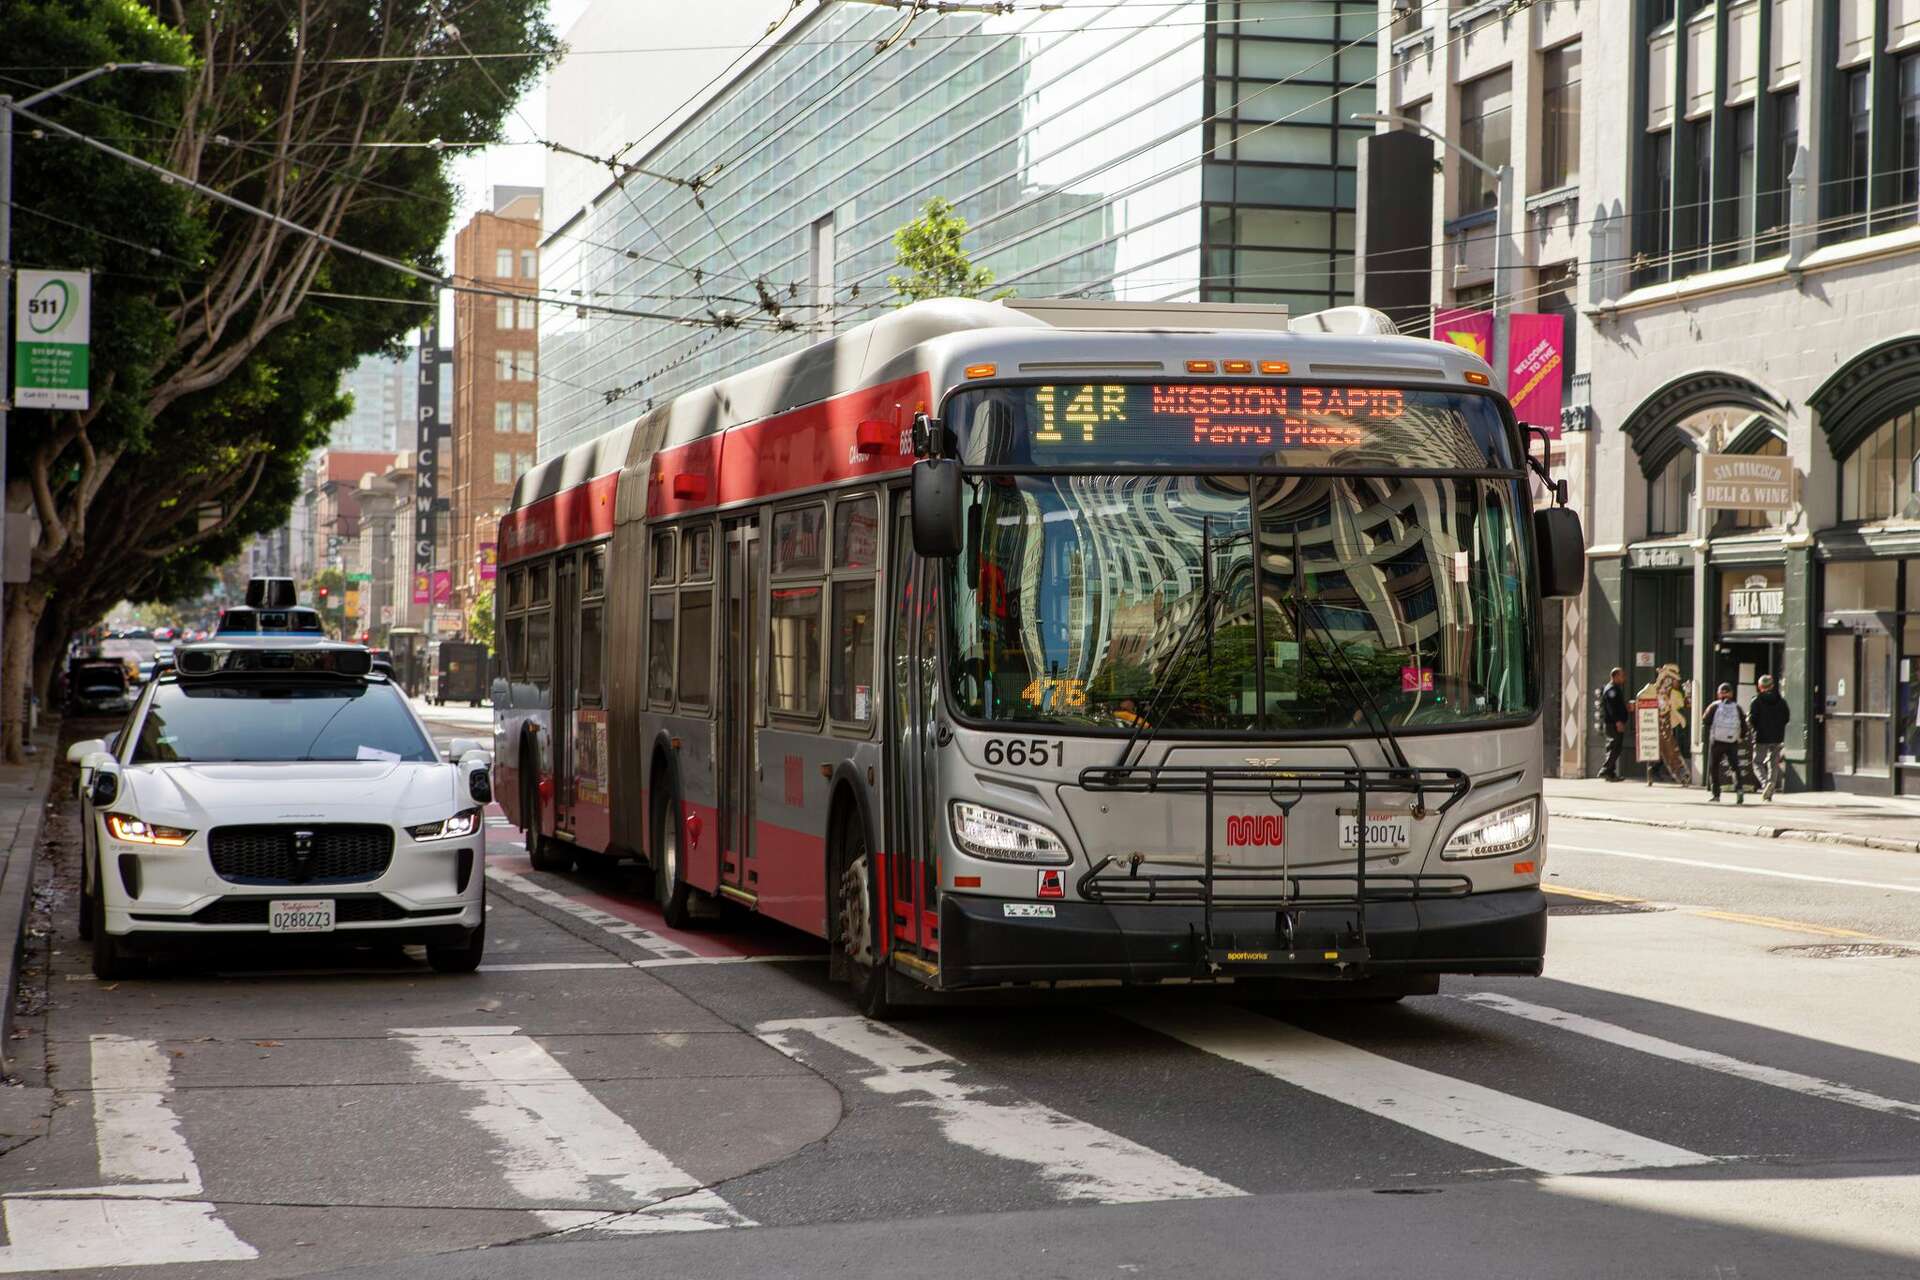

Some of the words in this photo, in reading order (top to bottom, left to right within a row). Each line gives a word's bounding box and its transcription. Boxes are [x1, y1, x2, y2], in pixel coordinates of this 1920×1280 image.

[28, 299, 56, 314] 511
[1514, 338, 1551, 375] WELCOME
[1528, 360, 1542, 374] TO
[1538, 345, 1557, 364] THE
[1036, 384, 1127, 441] 14R
[1153, 386, 1287, 415] MISSION
[1302, 387, 1404, 417] RAPID
[1193, 416, 1273, 445] Ferry
[1284, 418, 1362, 445] Plaza
[1706, 486, 1738, 503] DELI
[1740, 487, 1752, 503] &
[1754, 487, 1790, 504] WINE
[1729, 591, 1750, 616] DELI
[1759, 591, 1784, 615] WINE
[983, 738, 1064, 768] 6651
[1227, 951, 1269, 961] sportworks
